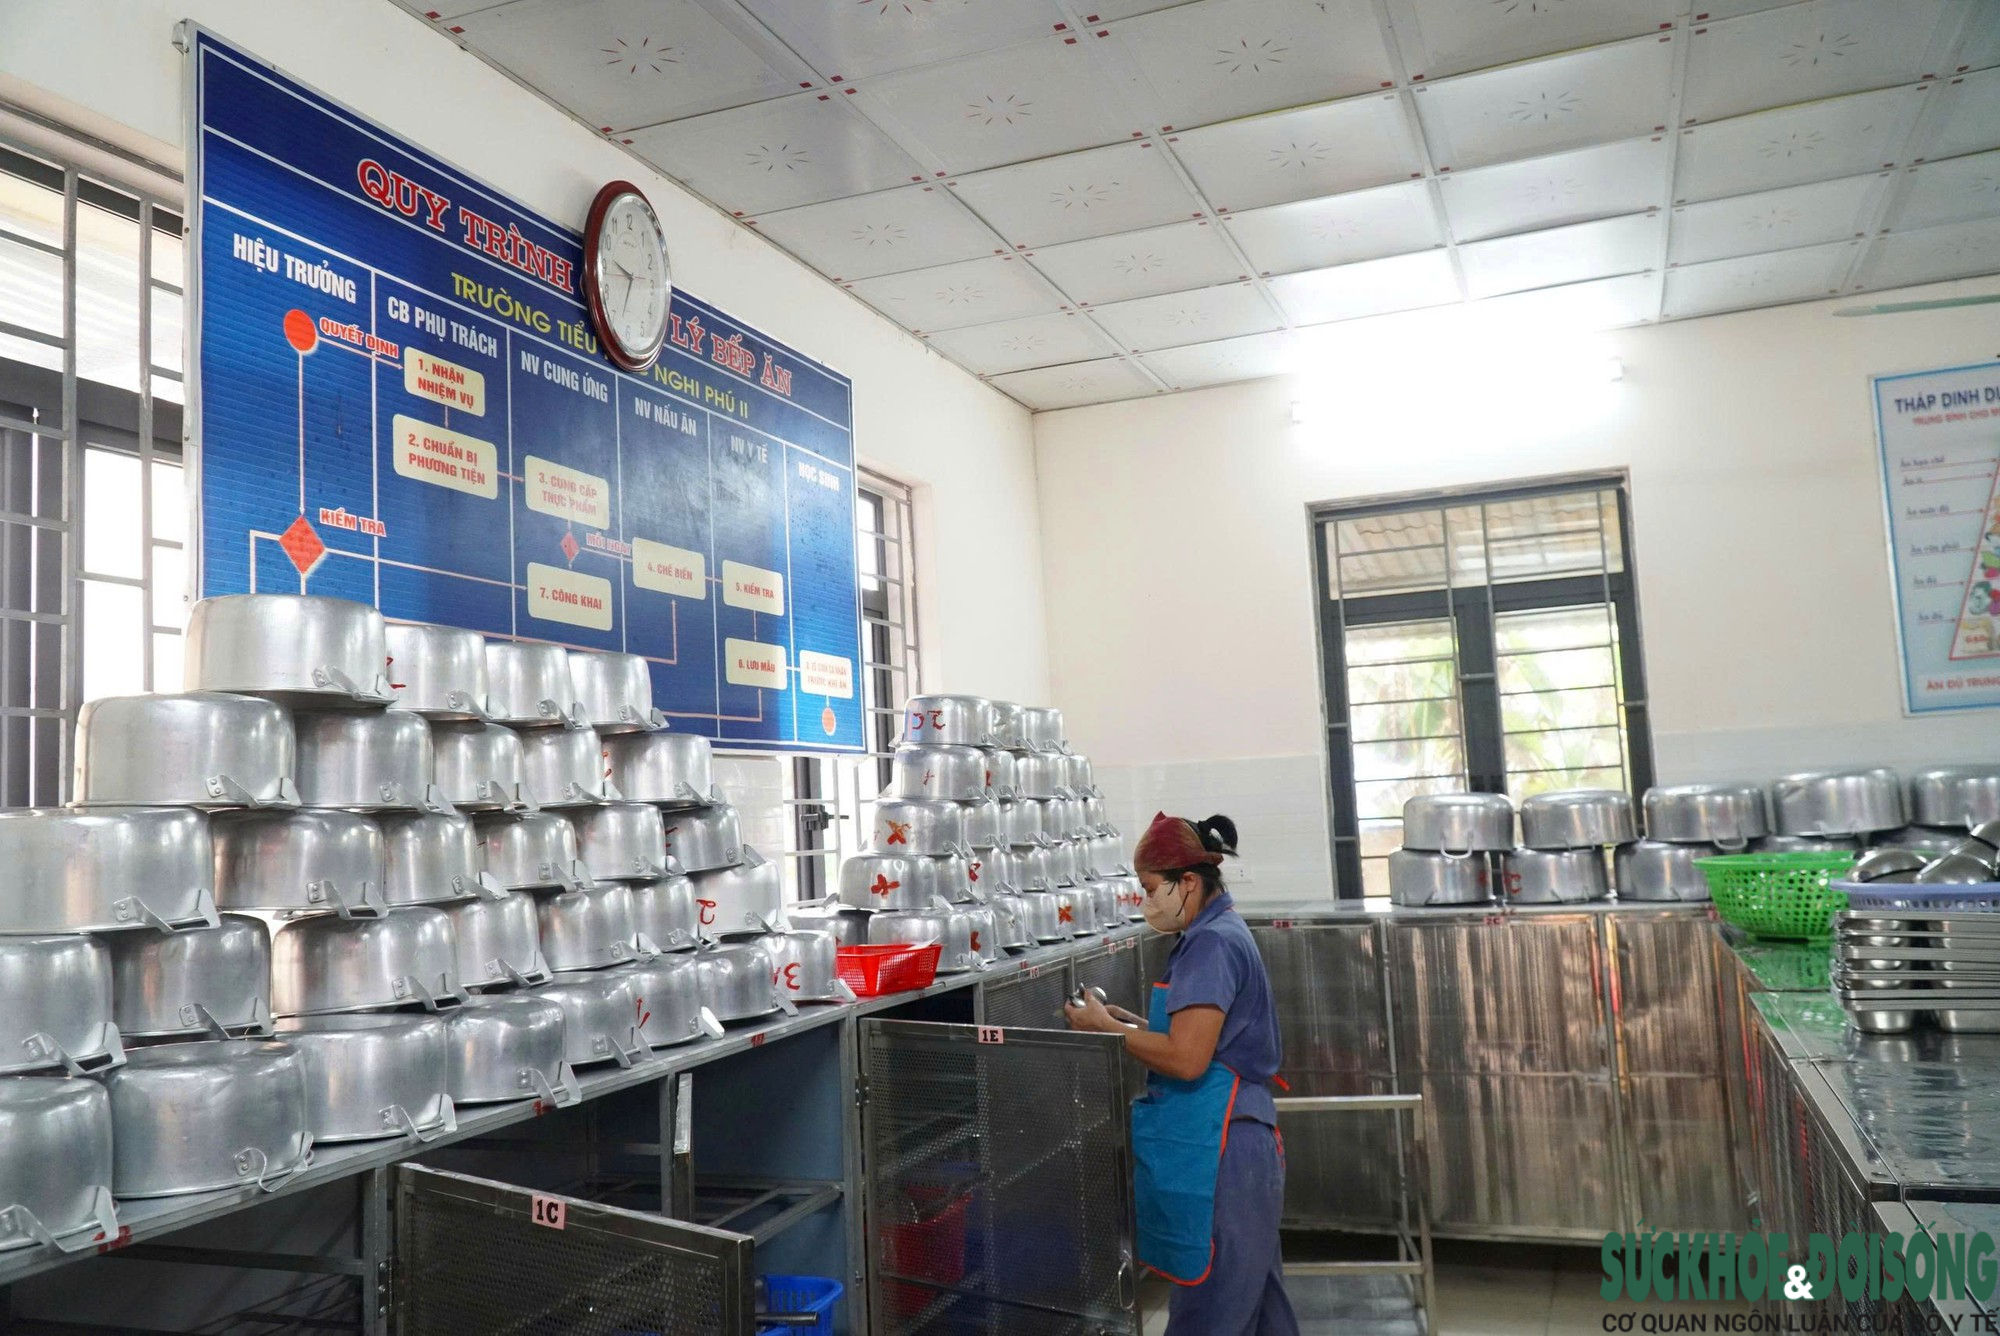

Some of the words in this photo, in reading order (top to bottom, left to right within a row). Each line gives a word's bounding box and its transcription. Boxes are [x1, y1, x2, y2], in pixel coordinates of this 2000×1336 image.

[233, 233, 278, 273] HIỆU
[284, 254, 356, 304] TRƯỞNG
[357, 158, 449, 231] QUY
[460, 207, 573, 294] TRÌNH
[671, 312, 705, 354] LÝ
[712, 335, 755, 377] BẾP
[761, 351, 792, 396] ĂN
[319, 316, 364, 346] QUYẾT
[365, 333, 399, 359] ĐỊNH
[388, 296, 409, 324] CB
[415, 307, 446, 343] PHỤ
[450, 320, 497, 358] TRÁCH
[451, 272, 551, 333] TRƯỜNG
[557, 321, 597, 354] TIỂU
[654, 362, 699, 399] NGHI
[705, 385, 735, 413] PHÚ
[740, 399, 749, 420] II
[418, 358, 429, 373] 1.
[432, 361, 465, 386] NHẬN
[521, 350, 539, 374] NV
[543, 359, 579, 392] CUNG
[583, 371, 608, 403] ỨNG
[417, 380, 456, 402] NHIỆM
[459, 391, 475, 409] VỤ
[1895, 391, 1936, 413] THÁP
[1941, 388, 1979, 409] DINH
[635, 397, 651, 419] NV
[654, 399, 678, 429] NẤU
[681, 412, 696, 437] ĂN
[408, 433, 420, 448] 2.
[423, 437, 463, 461] CHUẨN
[466, 449, 478, 466] BỊ
[730, 435, 745, 454] NV
[408, 452, 458, 478] PHƯƠNG
[460, 466, 486, 486] TIỆN
[538, 472, 548, 485] 3.
[550, 475, 577, 493] CUNG
[319, 507, 356, 531] KIỂM
[360, 517, 387, 538] TRA
[539, 587, 549, 599] 7.
[551, 588, 578, 605] CÔNG
[580, 595, 602, 610] KHAI
[982, 1029, 999, 1043] 1E
[537, 1199, 558, 1224] 1C
